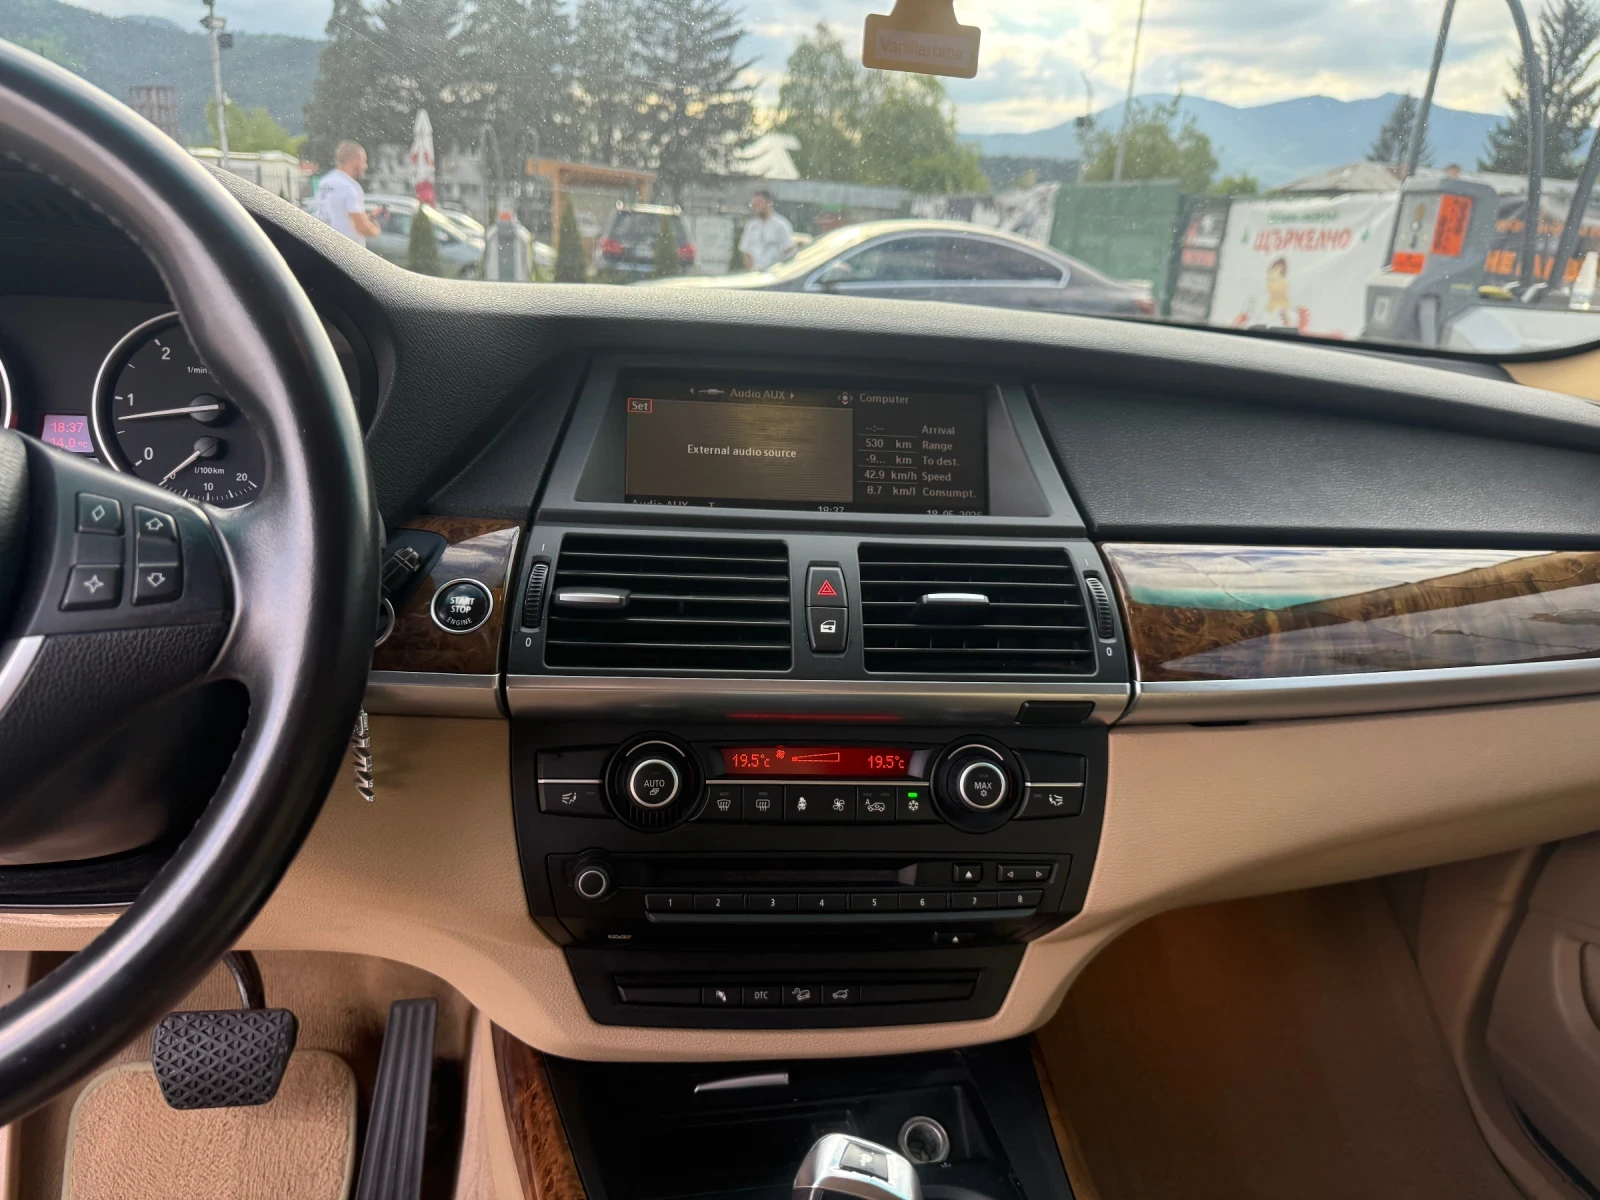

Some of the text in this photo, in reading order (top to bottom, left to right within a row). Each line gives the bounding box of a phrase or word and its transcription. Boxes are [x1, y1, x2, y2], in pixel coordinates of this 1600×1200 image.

[880, 36, 964, 60] Vanillaroma
[161, 347, 171, 360] 2
[730, 388, 786, 400] Audio AUX
[859, 394, 909, 404] Computer
[127, 393, 134, 406] 1
[632, 401, 648, 411] Set
[51, 422, 84, 433] 18:37
[922, 425, 955, 435] Arrival
[51, 436, 77, 448] 14.0
[865, 438, 953, 451] 530 km Range
[144, 447, 153, 461] 0
[687, 444, 797, 458] External audio source
[895, 455, 912, 464] km
[921, 456, 934, 466] To
[936, 457, 960, 467] dest.
[236, 472, 248, 482] 20
[864, 470, 952, 482] 42.9 km/h Speed
[204, 482, 214, 491] 10
[866, 485, 882, 495] 8.7
[922, 487, 976, 498] Consumpt.
[450, 596, 475, 605] START
[450, 605, 471, 614] STOP
[447, 616, 472, 625] ENGINE
[644, 779, 665, 787] AUTO
[974, 782, 992, 790] MAX
[668, 898, 672, 906] 1
[716, 898, 721, 906] 2
[770, 898, 775, 906] 3
[819, 898, 824, 906] 4
[872, 898, 877, 906] 5
[754, 991, 769, 1000] DTC
